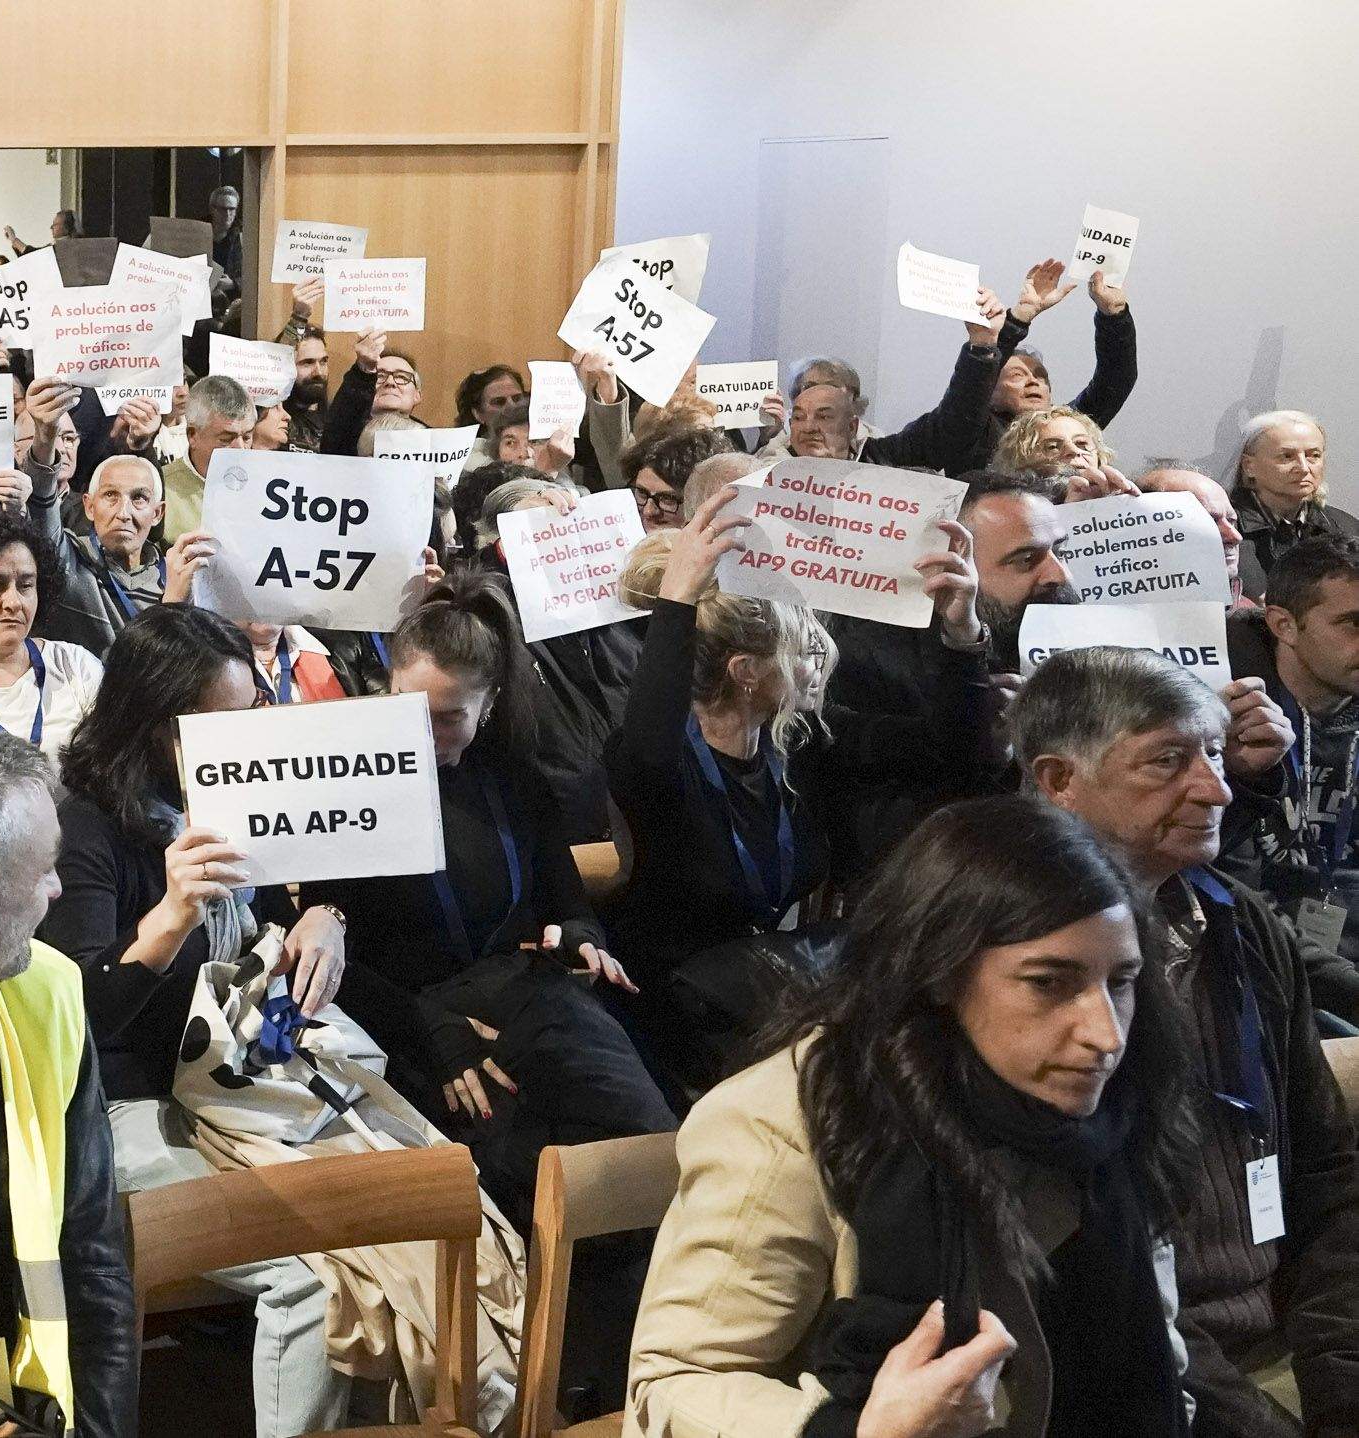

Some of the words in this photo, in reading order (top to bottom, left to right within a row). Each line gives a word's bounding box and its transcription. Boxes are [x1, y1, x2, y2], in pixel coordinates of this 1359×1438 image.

[289, 229, 296, 237] A
[1083, 226, 1131, 248] UIDADE
[289, 243, 335, 253] problemas
[337, 245, 348, 253] de
[286, 264, 304, 273] AP9
[339, 270, 347, 279] A
[350, 269, 389, 279] solución
[392, 271, 409, 279] aos
[632, 259, 674, 281] top
[342, 284, 392, 295] problemas
[395, 284, 406, 292] de
[51, 305, 63, 317] A
[66, 302, 126, 317] solución
[130, 303, 156, 313] aos
[339, 309, 360, 318] AP9
[363, 308, 409, 318] GRATUITA
[614, 278, 663, 331] Stop
[55, 322, 131, 339] problemas
[135, 319, 154, 333] de
[593, 315, 655, 363] A-57
[80, 342, 130, 355] tráfico:
[56, 361, 86, 374] AP9
[89, 357, 161, 371] GRATUITA
[700, 380, 774, 394] GRATUIDADE
[717, 403, 732, 413] DA
[736, 402, 759, 412] AP-9
[779, 475, 872, 505] solución
[878, 496, 920, 514] aos
[261, 478, 369, 536] Stop
[520, 531, 531, 545] A
[532, 516, 600, 543] solución
[755, 501, 873, 535] problemas
[879, 520, 907, 541] de
[1072, 511, 1148, 536] solución
[1152, 509, 1183, 522] aos
[530, 540, 612, 572] problemas
[786, 532, 864, 561] tráfico:
[1064, 535, 1158, 563] problemas
[1162, 528, 1185, 544] de
[255, 546, 376, 592] A-57
[559, 563, 617, 585] tráfico:
[739, 550, 786, 571] AP9
[791, 559, 898, 595] GRATUITA
[1095, 557, 1159, 578] tráfico:
[1081, 586, 1103, 602] P9
[1108, 571, 1201, 598] GRATUITA
[544, 593, 570, 613] AP9
[195, 751, 419, 787] GRATUIDADE
[248, 812, 295, 838] DA
[304, 807, 378, 835] AP-9
